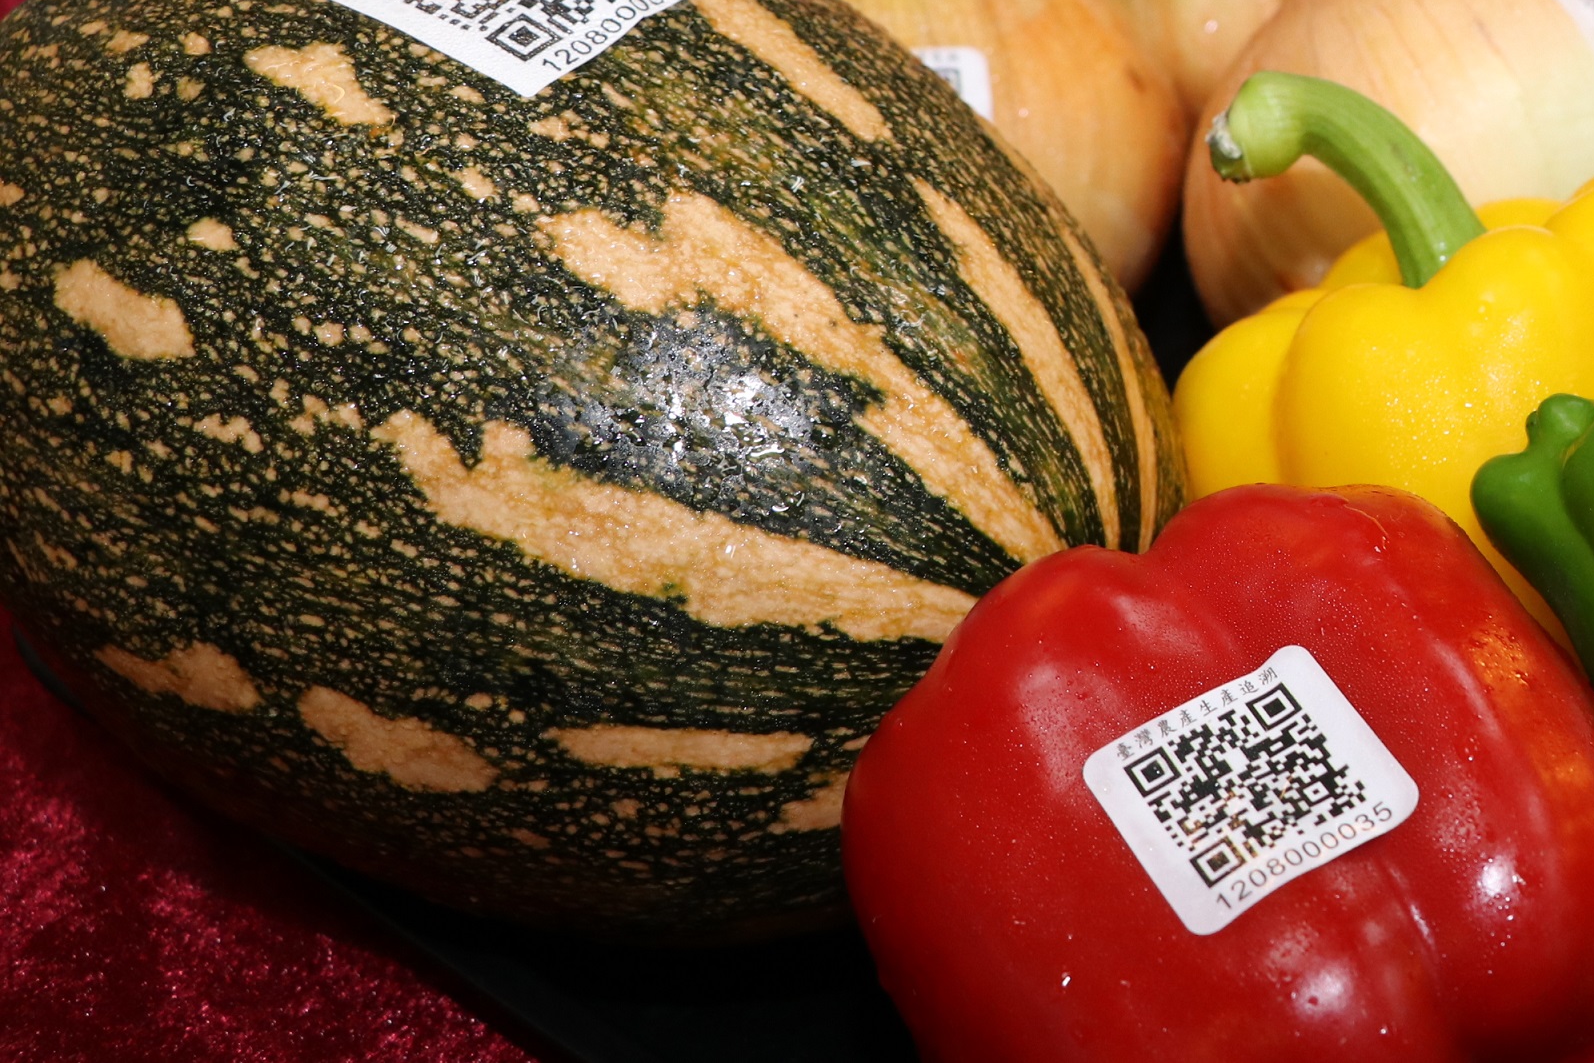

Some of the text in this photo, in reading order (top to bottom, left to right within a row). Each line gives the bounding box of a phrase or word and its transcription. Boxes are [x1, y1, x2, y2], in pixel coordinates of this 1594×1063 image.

[1116, 666, 1279, 761] 臺灣農產生產追溯
[1215, 801, 1394, 911] 1208000035
